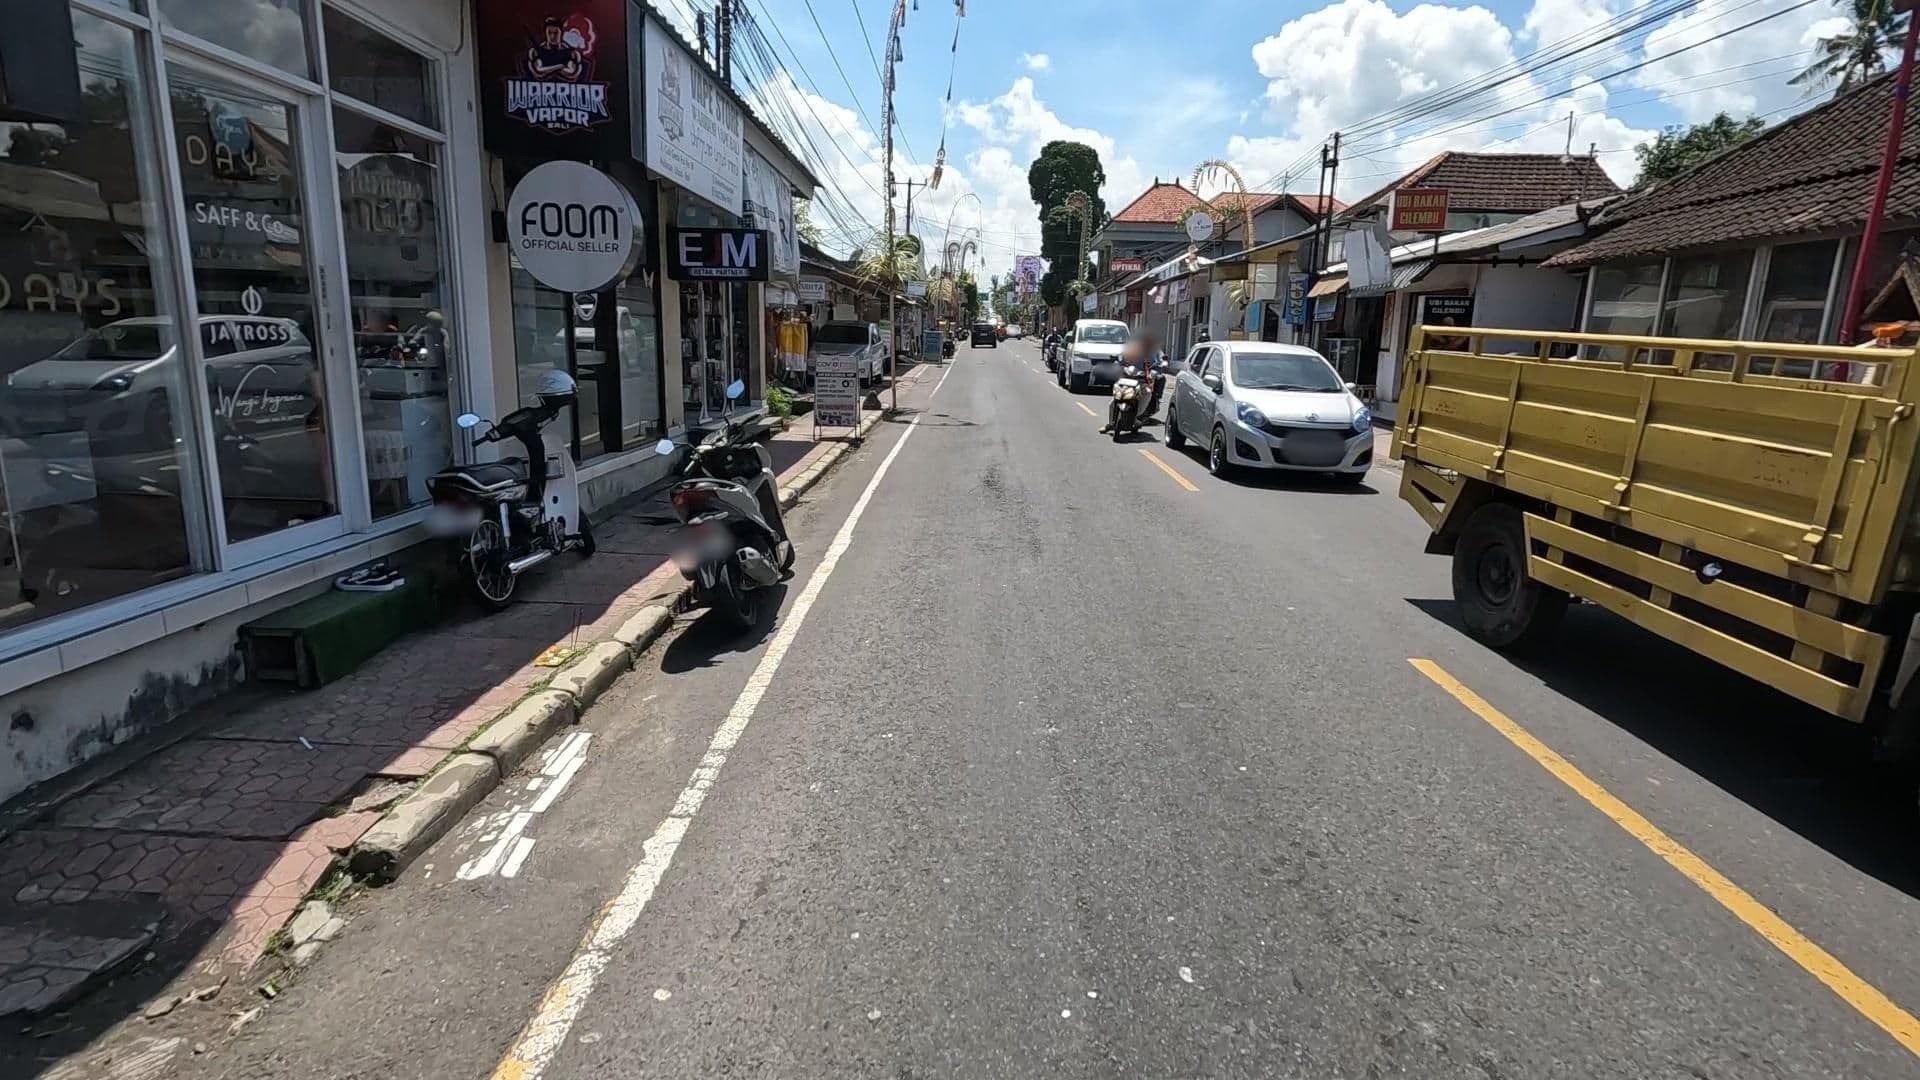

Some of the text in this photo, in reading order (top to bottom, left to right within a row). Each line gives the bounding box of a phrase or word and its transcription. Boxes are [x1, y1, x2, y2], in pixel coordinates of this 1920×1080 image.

[507, 80, 608, 117] WARRIOR
[527, 107, 589, 127] VAPOR
[195, 202, 240, 228] SAFF
[521, 202, 619, 240] FOOM
[1399, 211, 1440, 225] CILEMBU
[521, 239, 619, 253] OFFICIAL SELLER
